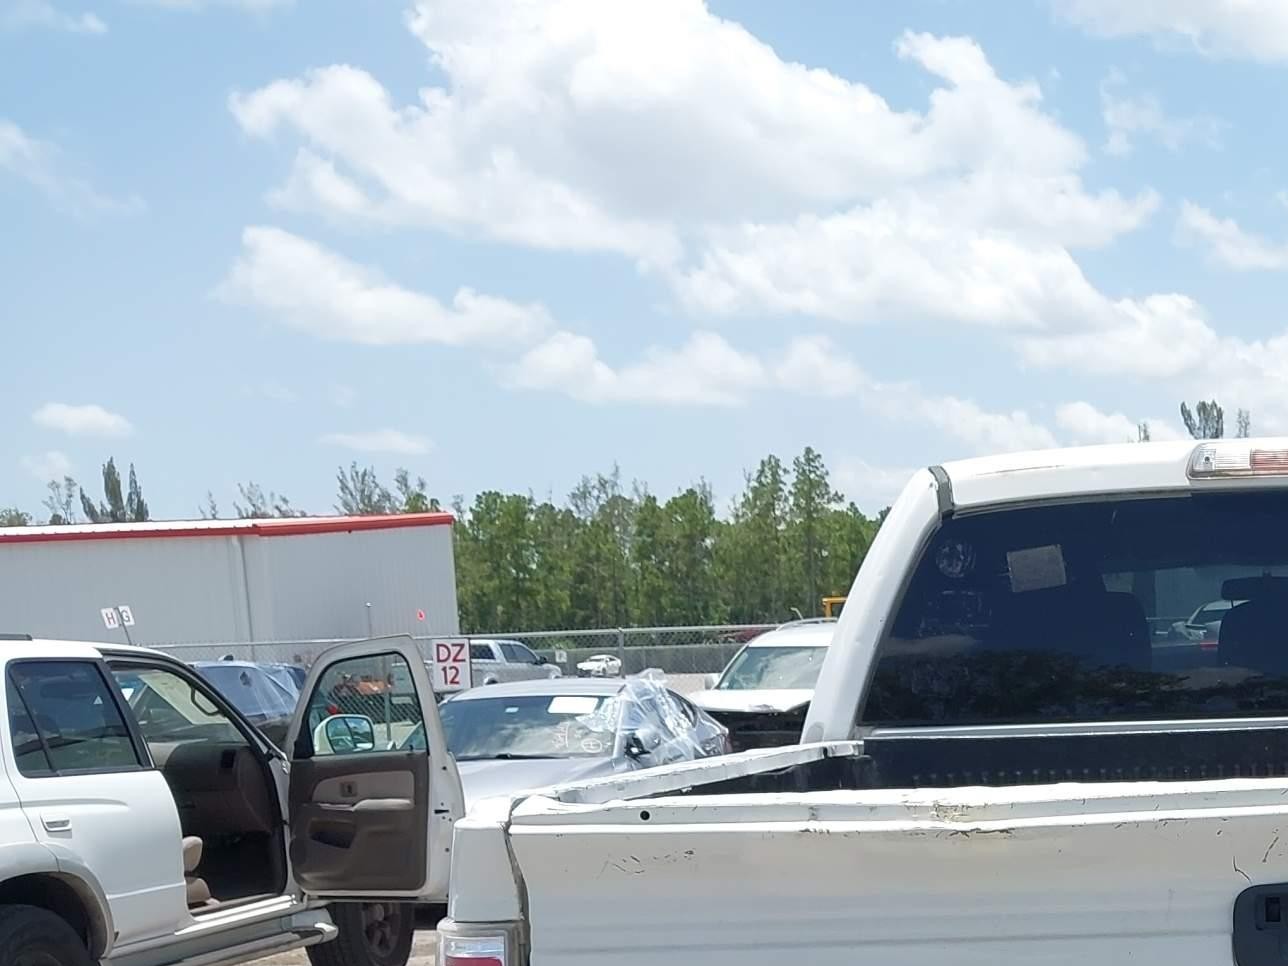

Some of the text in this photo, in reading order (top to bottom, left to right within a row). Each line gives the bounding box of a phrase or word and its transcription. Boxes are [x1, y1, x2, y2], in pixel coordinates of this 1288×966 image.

[105, 611, 117, 625] H
[121, 609, 131, 623] G
[436, 643, 466, 663] DZ
[441, 665, 460, 685] 12
